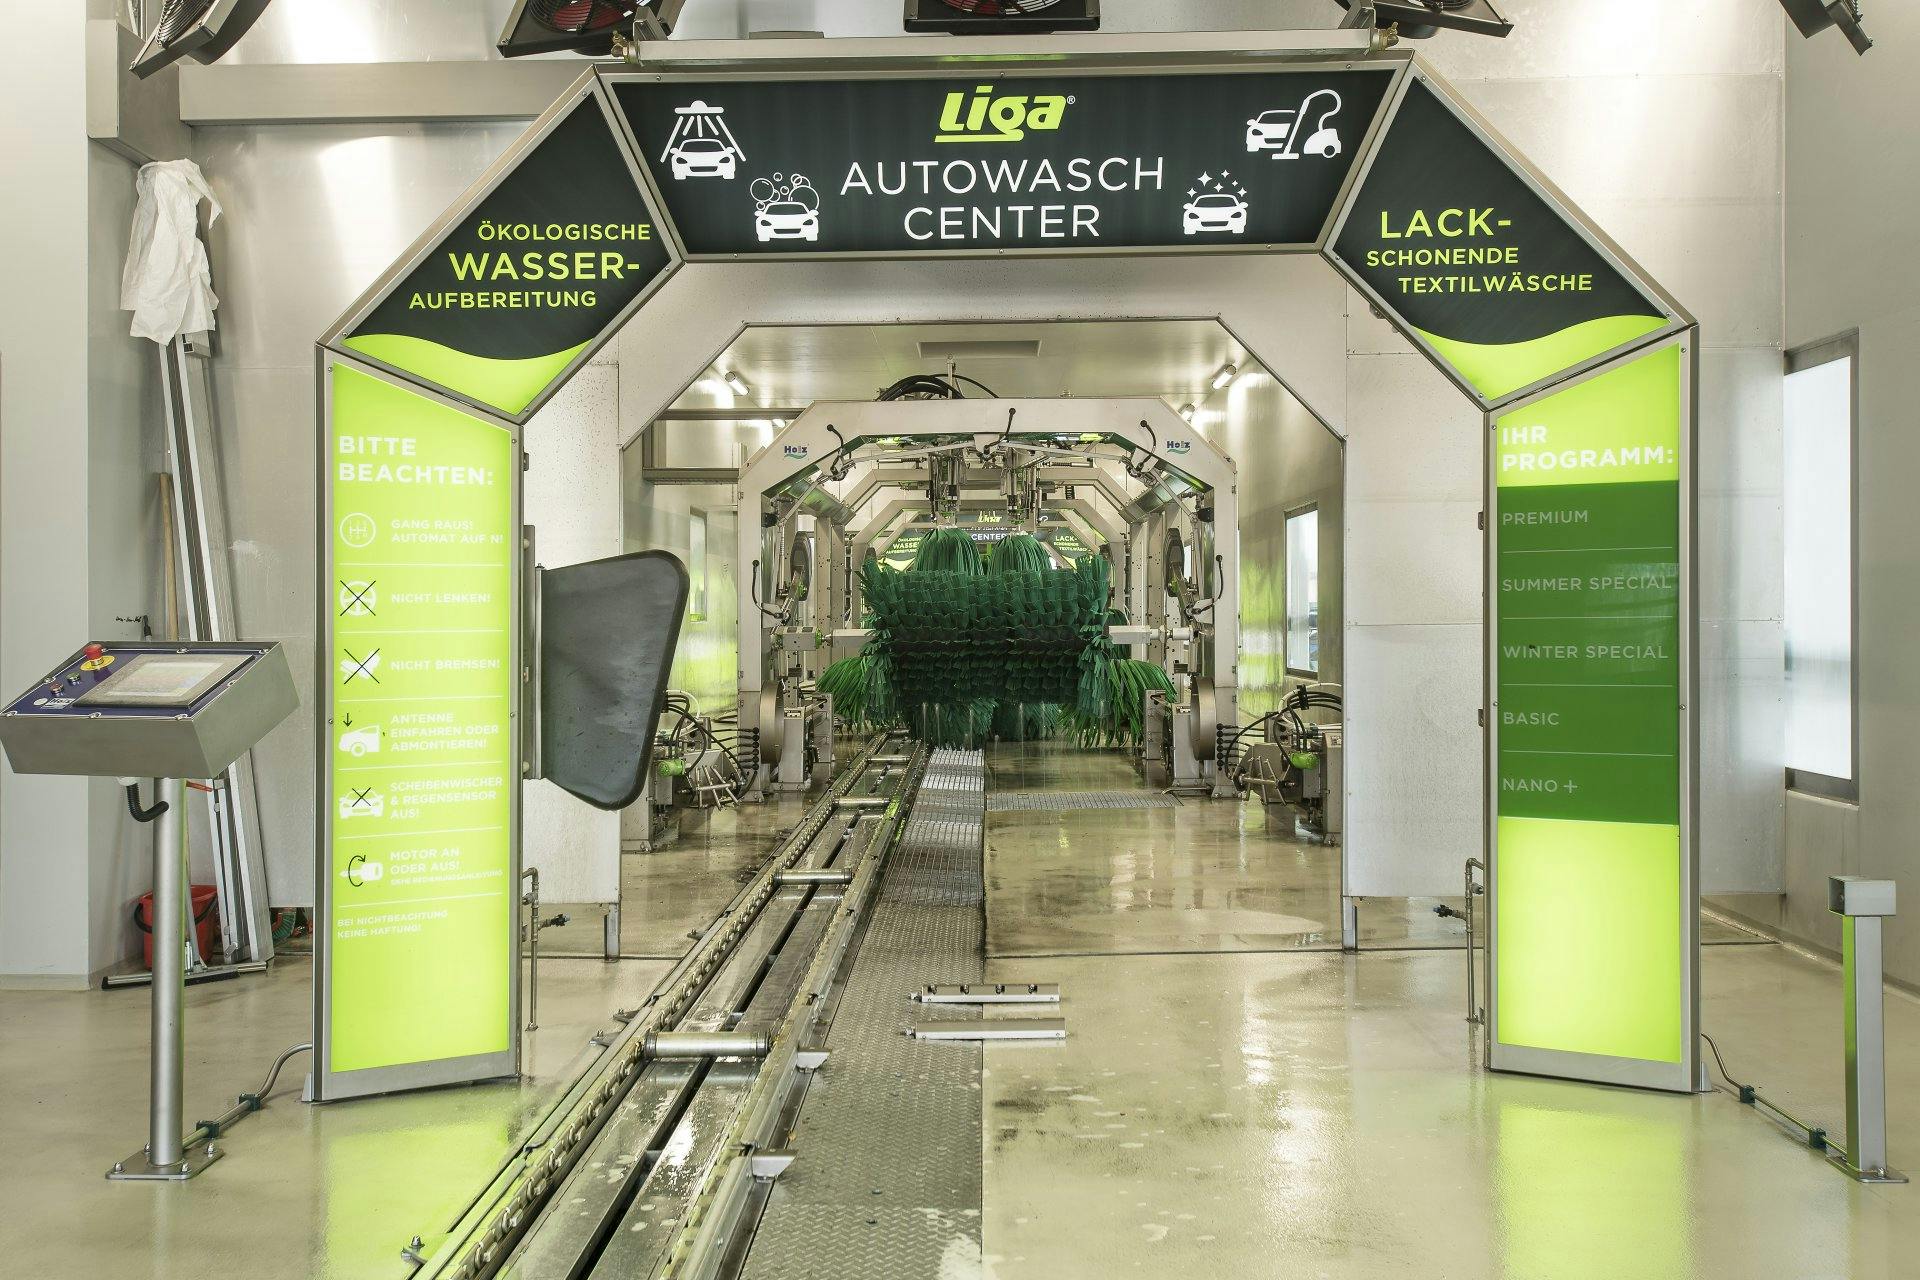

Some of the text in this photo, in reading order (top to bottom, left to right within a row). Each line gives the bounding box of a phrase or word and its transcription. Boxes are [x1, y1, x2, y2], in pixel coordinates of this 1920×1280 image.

[840, 156, 1164, 195] AUTOWASCH
[904, 204, 1101, 241] CENTER
[1381, 207, 1512, 239] LACK-
[477, 221, 651, 241] ÖKOLOGISCHE
[1366, 247, 1519, 267] SCHONENDE
[449, 252, 640, 281] WASSER-
[1398, 272, 1593, 294] TEXTILWÄSCHE
[409, 291, 597, 310] AUFBEREITUNG
[1502, 425, 1548, 446] IHR
[338, 435, 417, 457] BITTE
[1502, 445, 1674, 472] PROGRAMM:
[338, 462, 494, 486] BEACHTEN:
[391, 519, 474, 531] GANG RAUS!
[1502, 509, 1589, 525] PREMIUM
[391, 533, 456, 544] AUTOMAT
[460, 534, 486, 544] AUF
[1502, 575, 1672, 592] SUMMER SPECIAL
[391, 593, 491, 604] NICHT LENKEN!
[1503, 644, 1669, 660] WINTER SPECIAL
[390, 658, 501, 671] NICHT BREMSEN!
[390, 712, 454, 724] ANTENNE
[1503, 711, 1560, 726] BASIC
[390, 724, 499, 738] EINFAHREN ODER
[390, 739, 487, 752] ABMONTIEREN!
[390, 776, 503, 792] SCHEIBENWISCHER
[1503, 777, 1578, 794] NANO +
[390, 790, 497, 806] & REGENSENSOR
[390, 808, 419, 819] AUS!
[390, 847, 460, 860] MOTOR AN
[390, 860, 460, 875] ODER AUS!
[337, 909, 448, 927] BEI NICHTBEACHTUNG
[337, 928, 368, 939] KEINE
